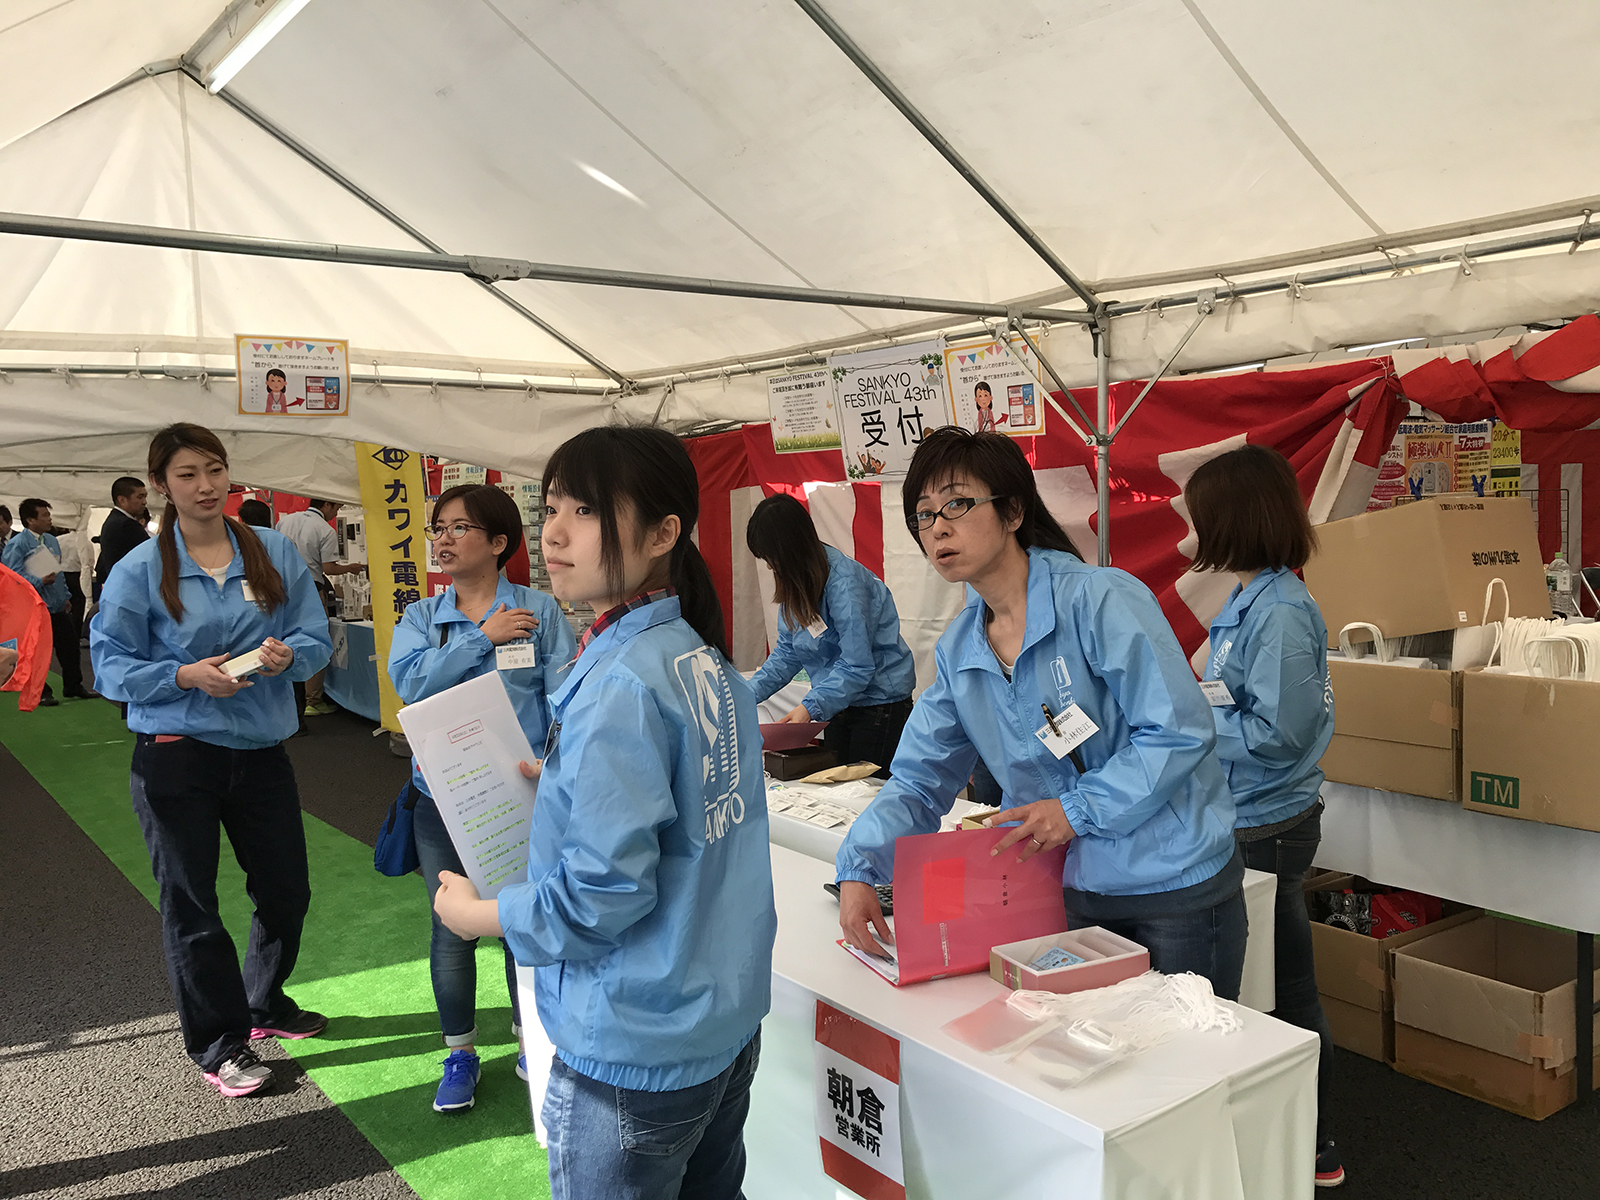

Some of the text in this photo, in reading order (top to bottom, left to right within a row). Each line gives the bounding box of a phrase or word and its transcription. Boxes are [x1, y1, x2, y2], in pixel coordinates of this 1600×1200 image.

[843, 385, 937, 409] FESTIVAL 43th
[857, 372, 911, 392] SANKYO
[861, 405, 924, 448] 受付
[384, 479, 421, 624] カワイ電線
[1476, 776, 1514, 806] TM
[827, 1066, 886, 1136] 朝倉
[835, 1113, 881, 1158] 営業所
